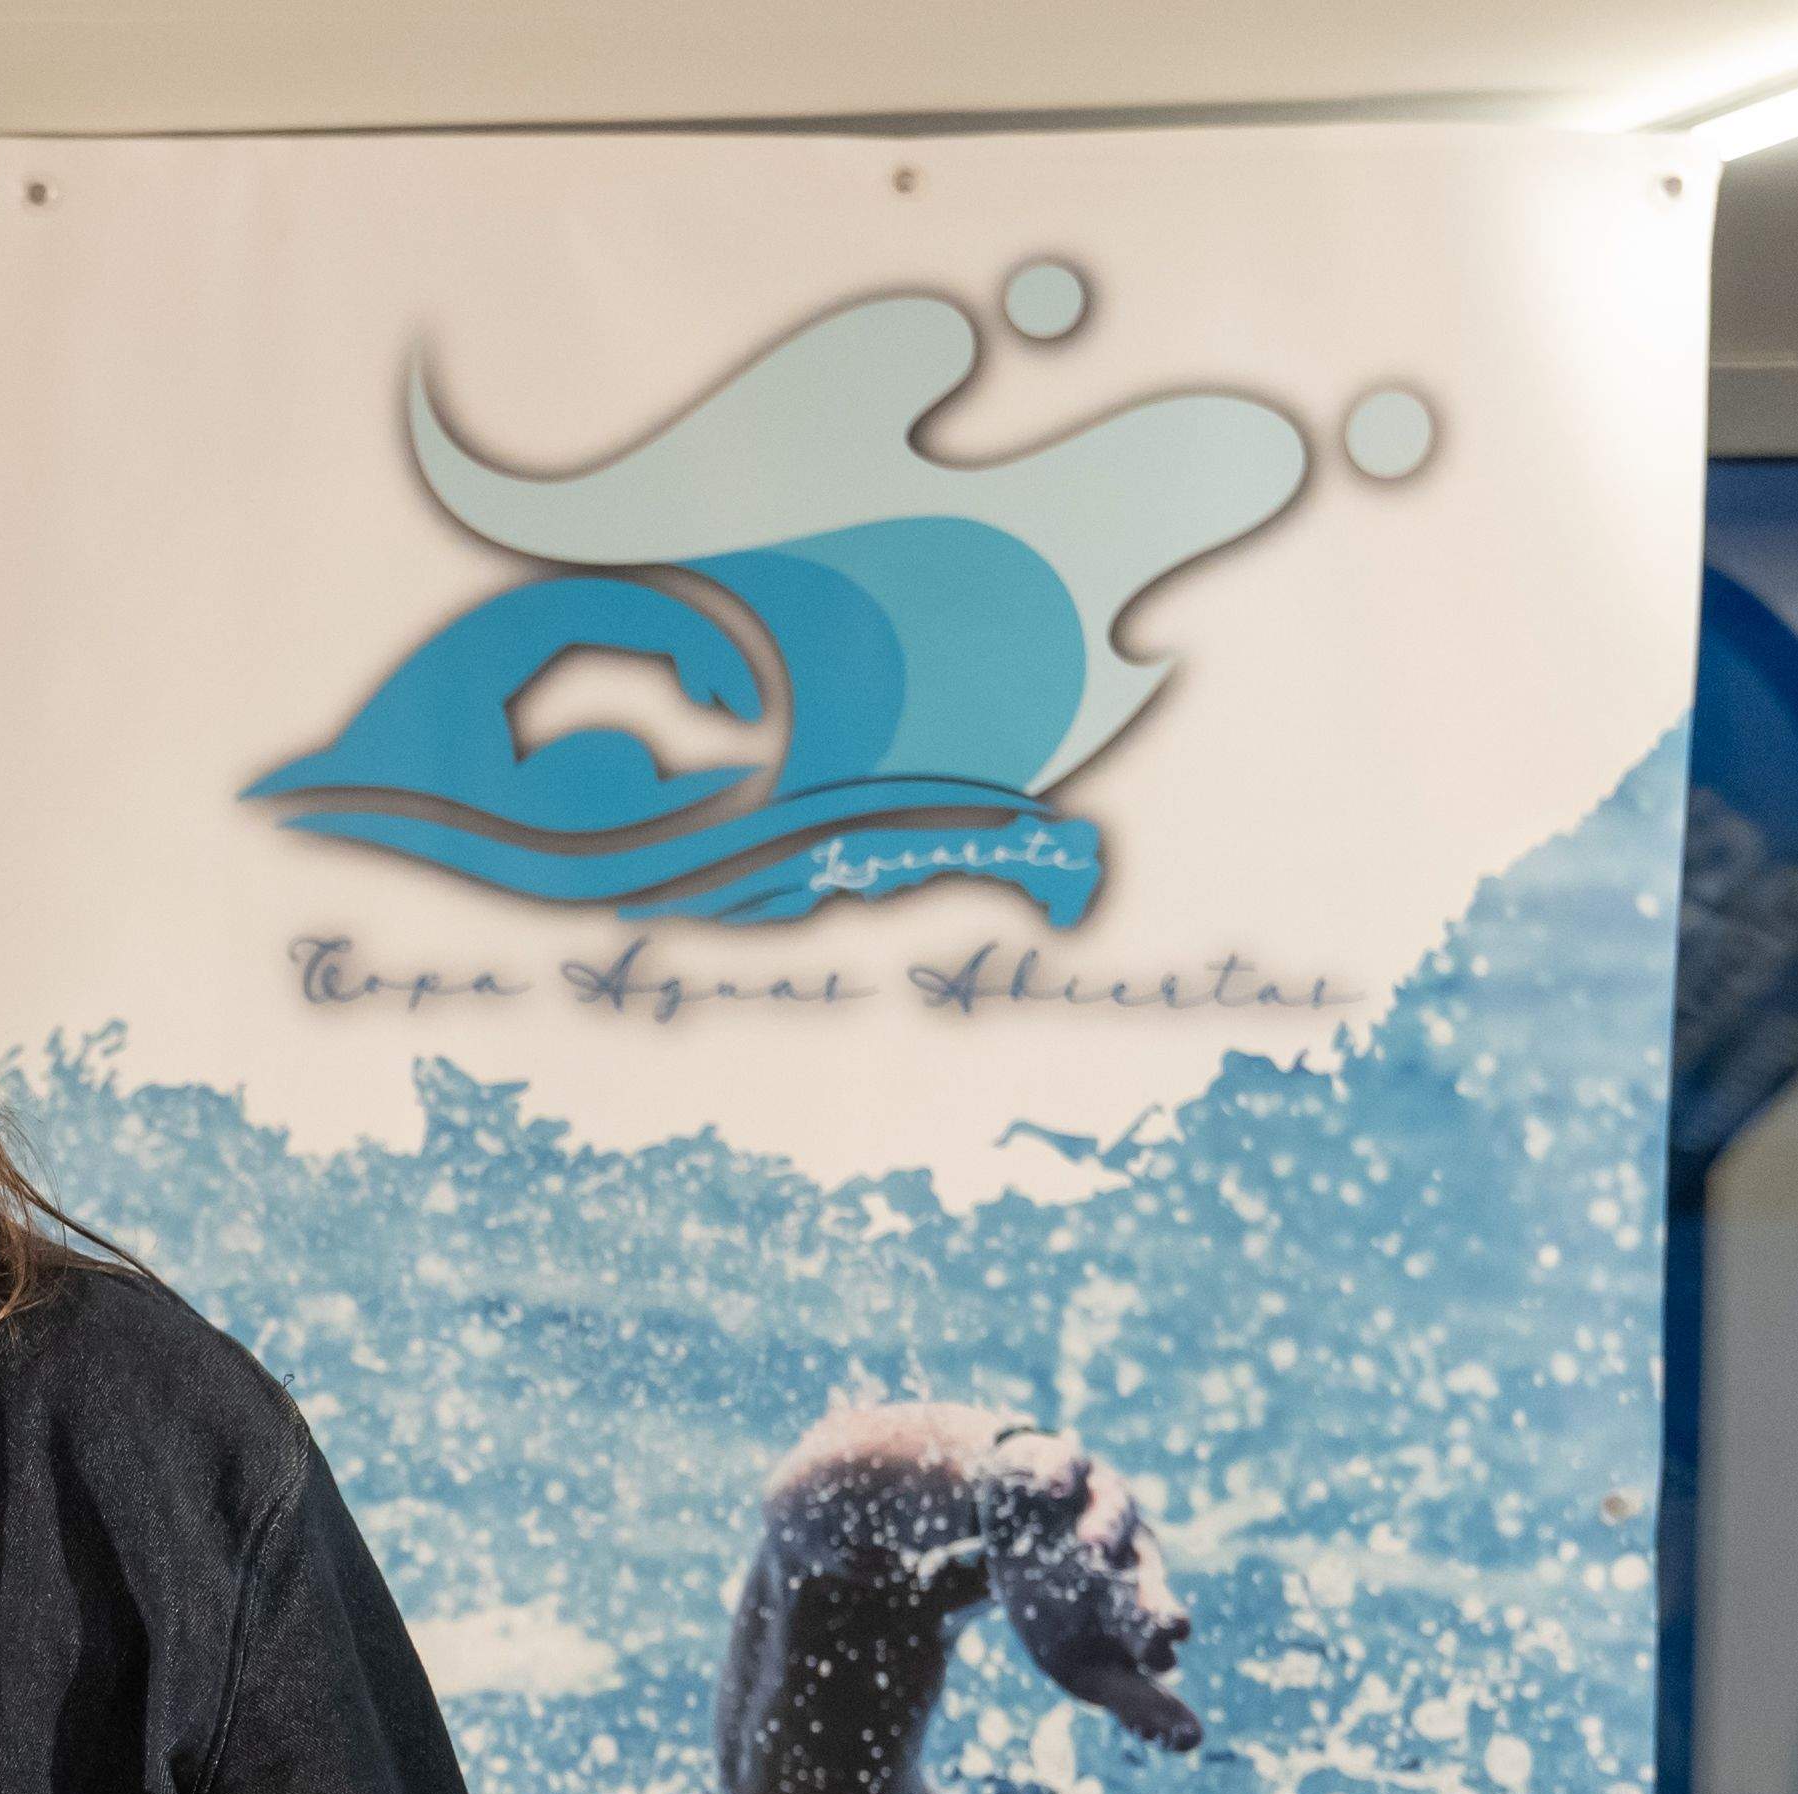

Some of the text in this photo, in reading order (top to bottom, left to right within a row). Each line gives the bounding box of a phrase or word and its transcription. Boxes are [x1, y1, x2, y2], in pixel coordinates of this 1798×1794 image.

[286, 934, 1365, 1022] Copa Aguas Abiertas
